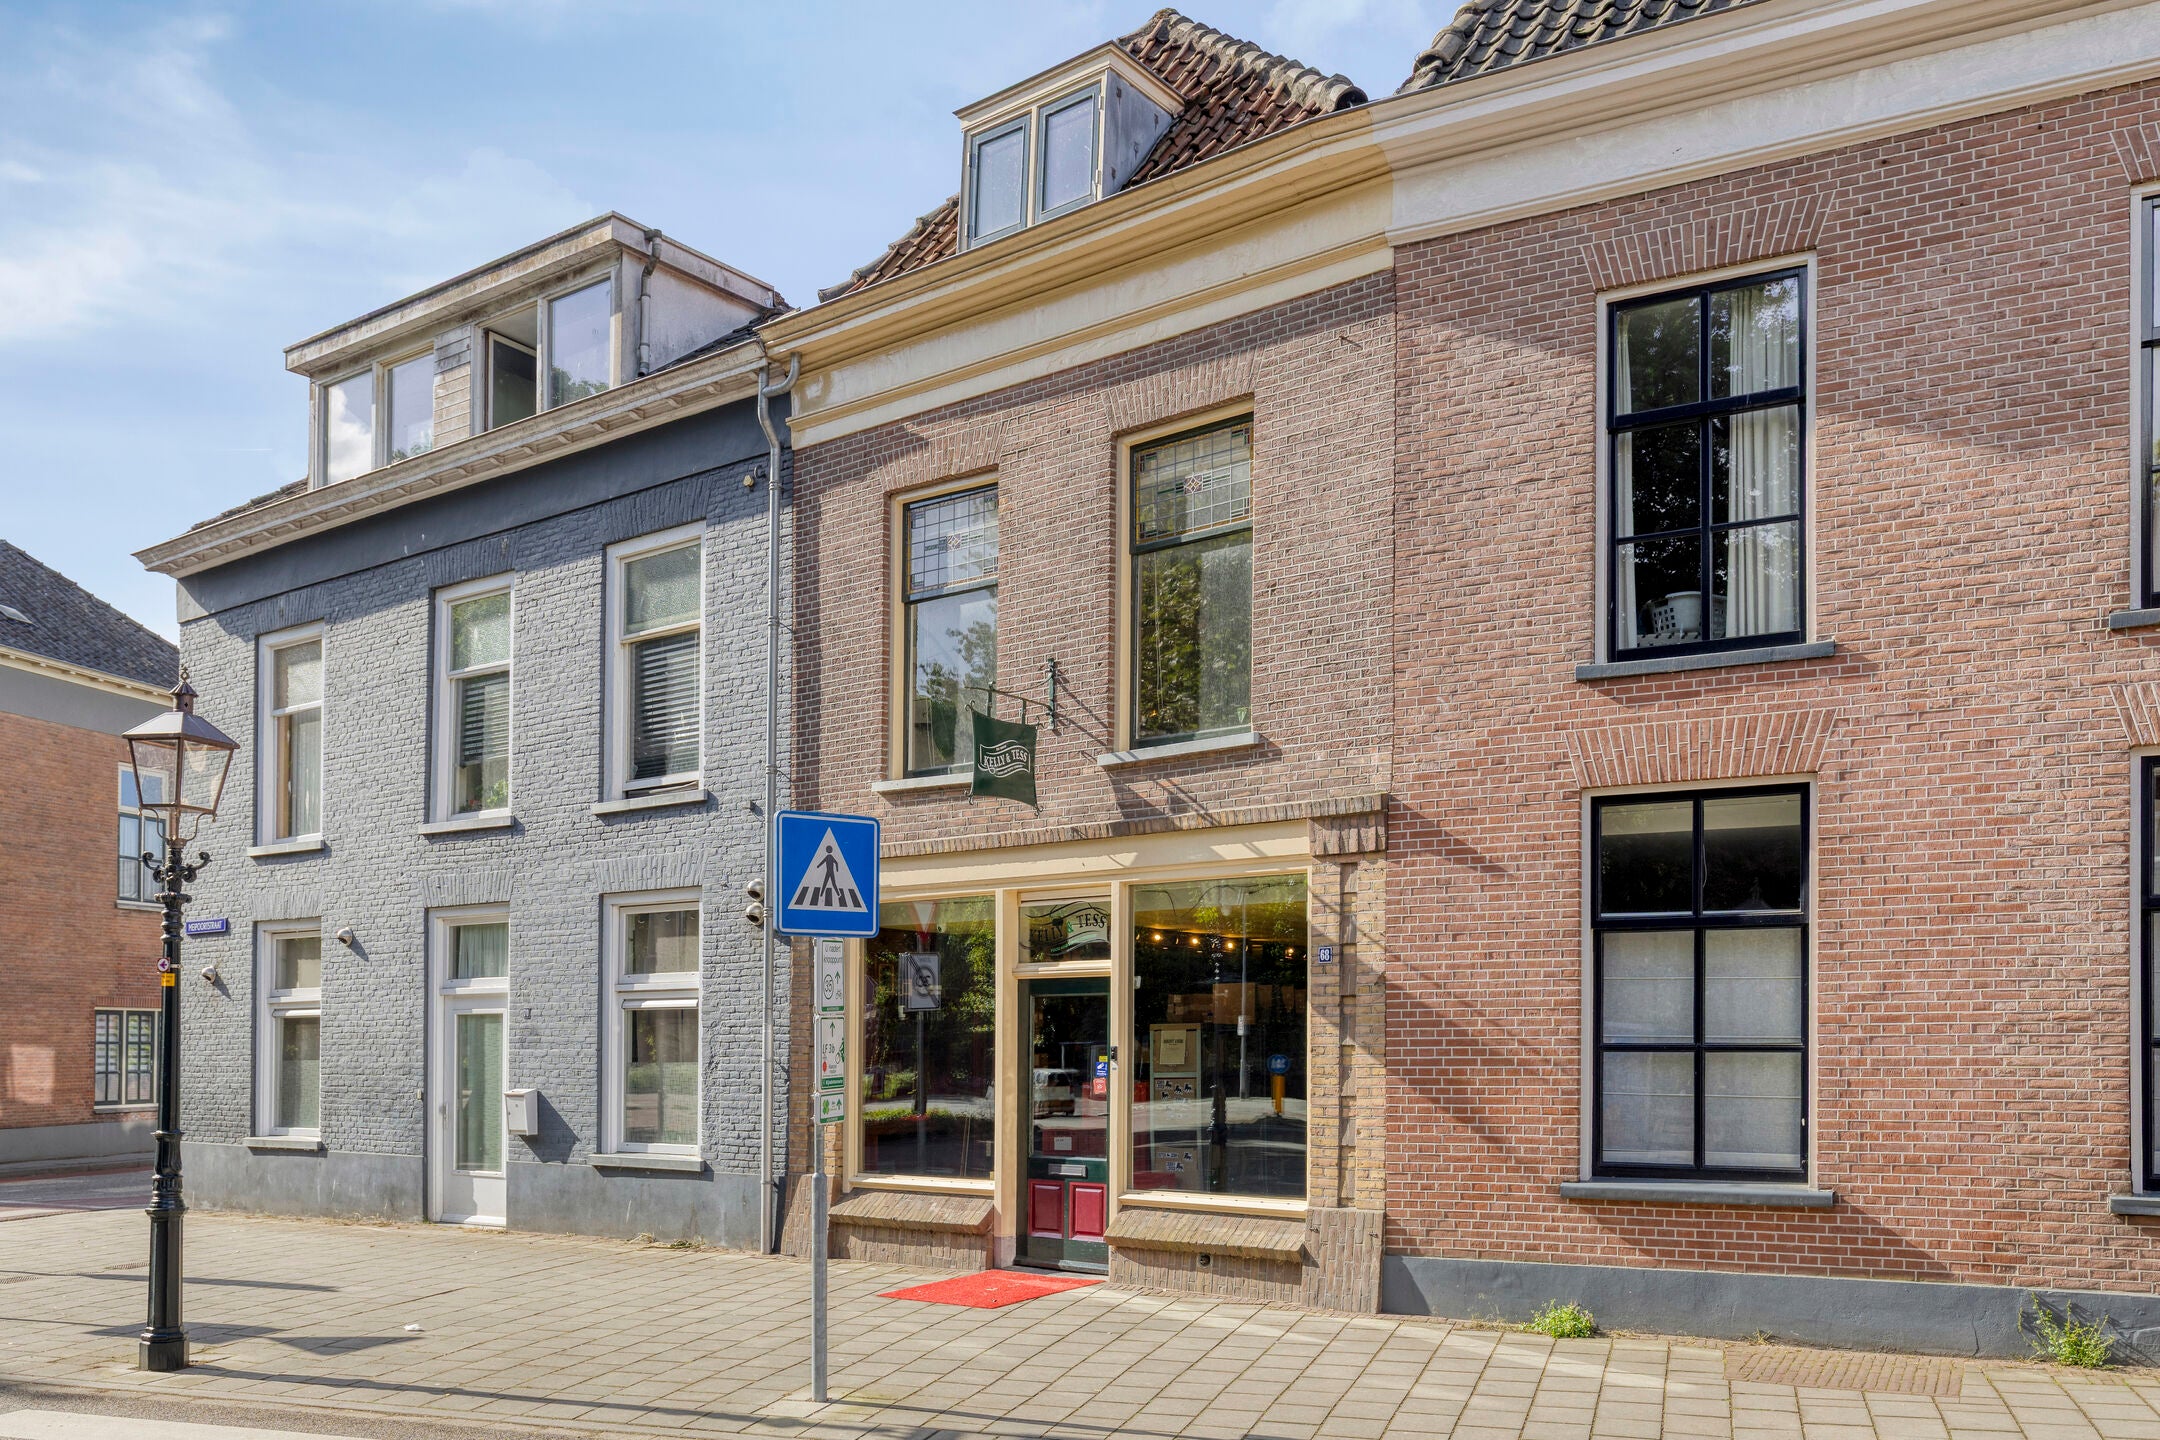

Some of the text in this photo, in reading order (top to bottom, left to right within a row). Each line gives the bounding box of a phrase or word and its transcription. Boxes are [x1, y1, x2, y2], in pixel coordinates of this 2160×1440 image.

[983, 749, 1028, 767] KELLY & TESS
[1066, 920, 1074, 933] &
[1076, 913, 1107, 928] TESS
[1320, 949, 1330, 961] 68
